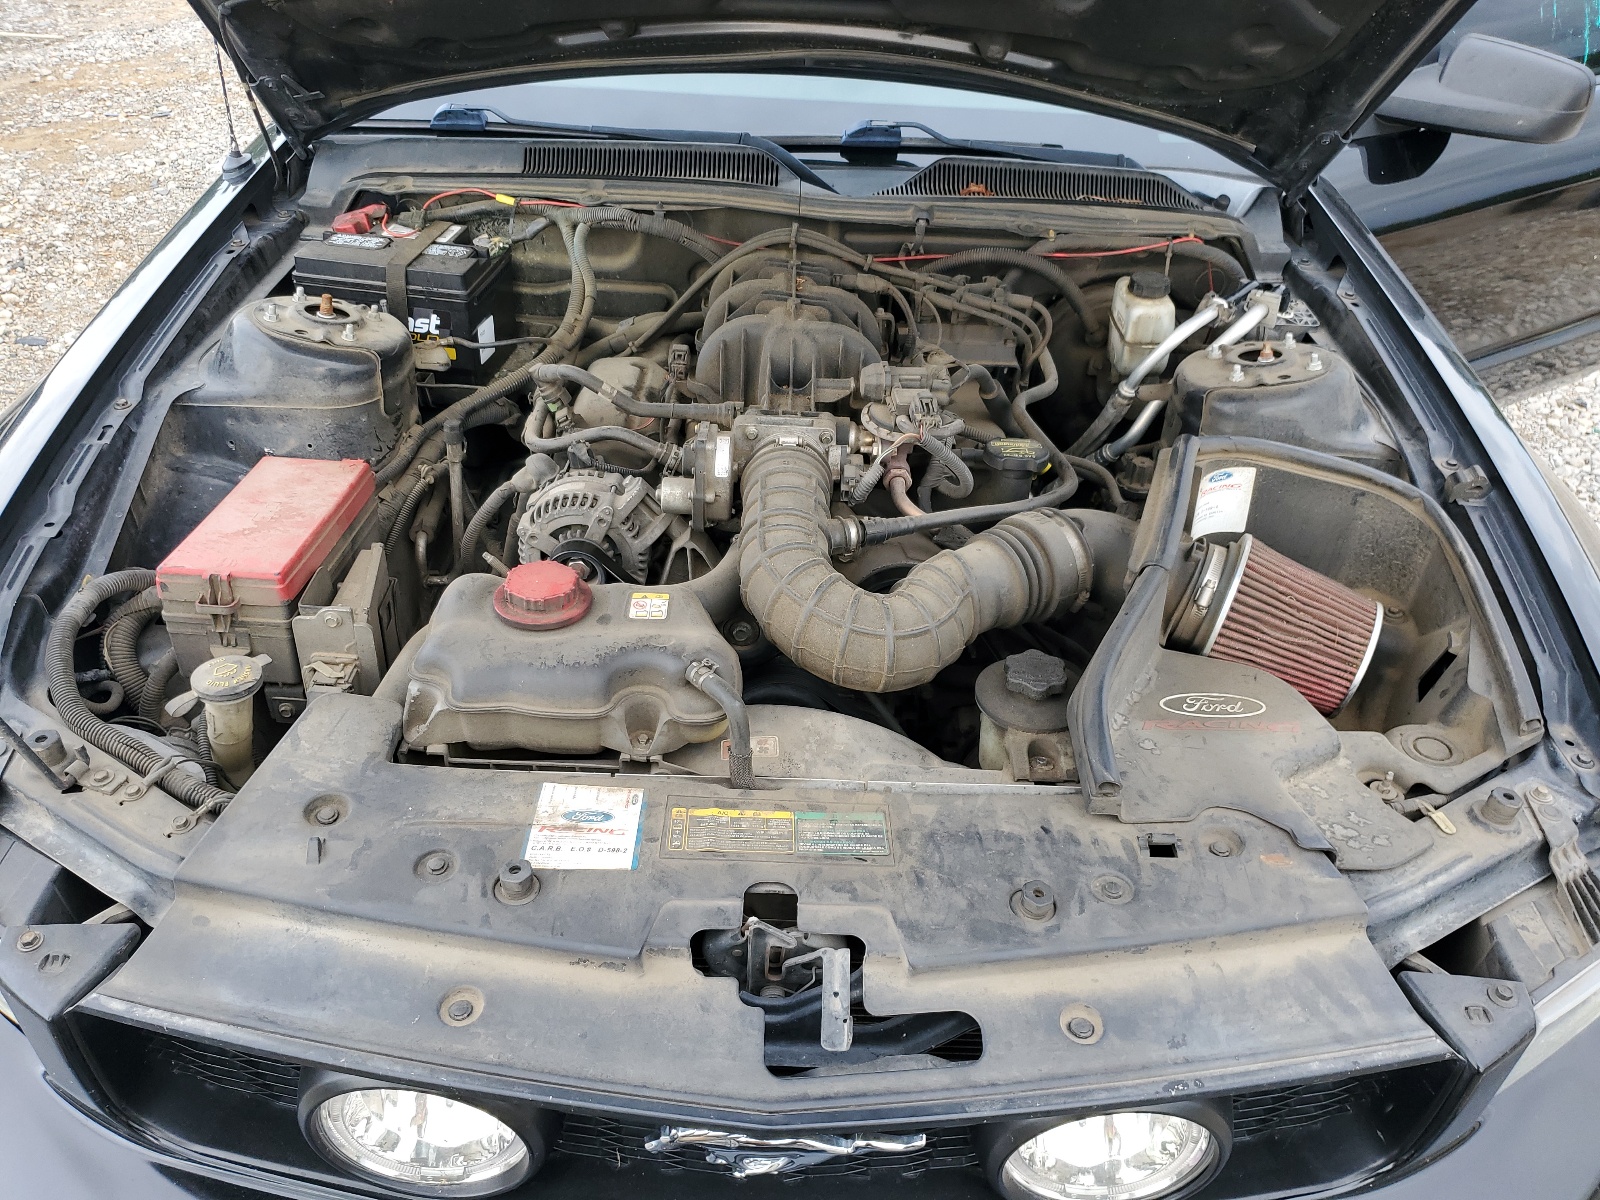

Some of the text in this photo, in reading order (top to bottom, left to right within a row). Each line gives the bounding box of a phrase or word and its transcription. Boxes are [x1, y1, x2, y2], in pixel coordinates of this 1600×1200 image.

[1201, 483, 1242, 497] RACING
[206, 679, 230, 687] FLUID
[1182, 696, 1244, 713] Ford
[1142, 719, 1302, 732] RACING
[570, 810, 606, 823] Ford
[537, 825, 628, 836] RACING
